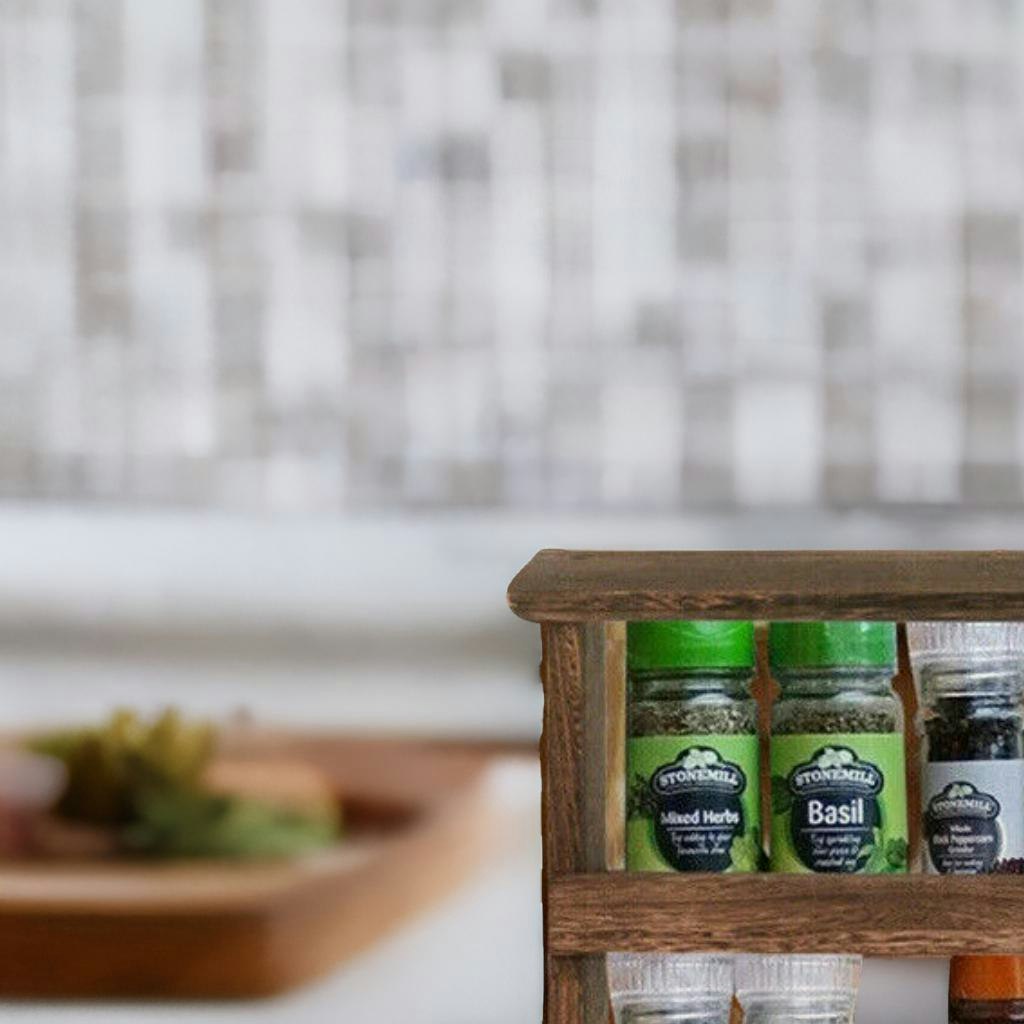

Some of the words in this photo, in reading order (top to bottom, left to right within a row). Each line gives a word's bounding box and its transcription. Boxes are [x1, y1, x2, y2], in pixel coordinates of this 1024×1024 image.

[659, 768, 738, 787] STONEMILL
[794, 768, 875, 787] STONEMILL
[703, 809, 739, 824] Herbs
[808, 798, 864, 825] Basil
